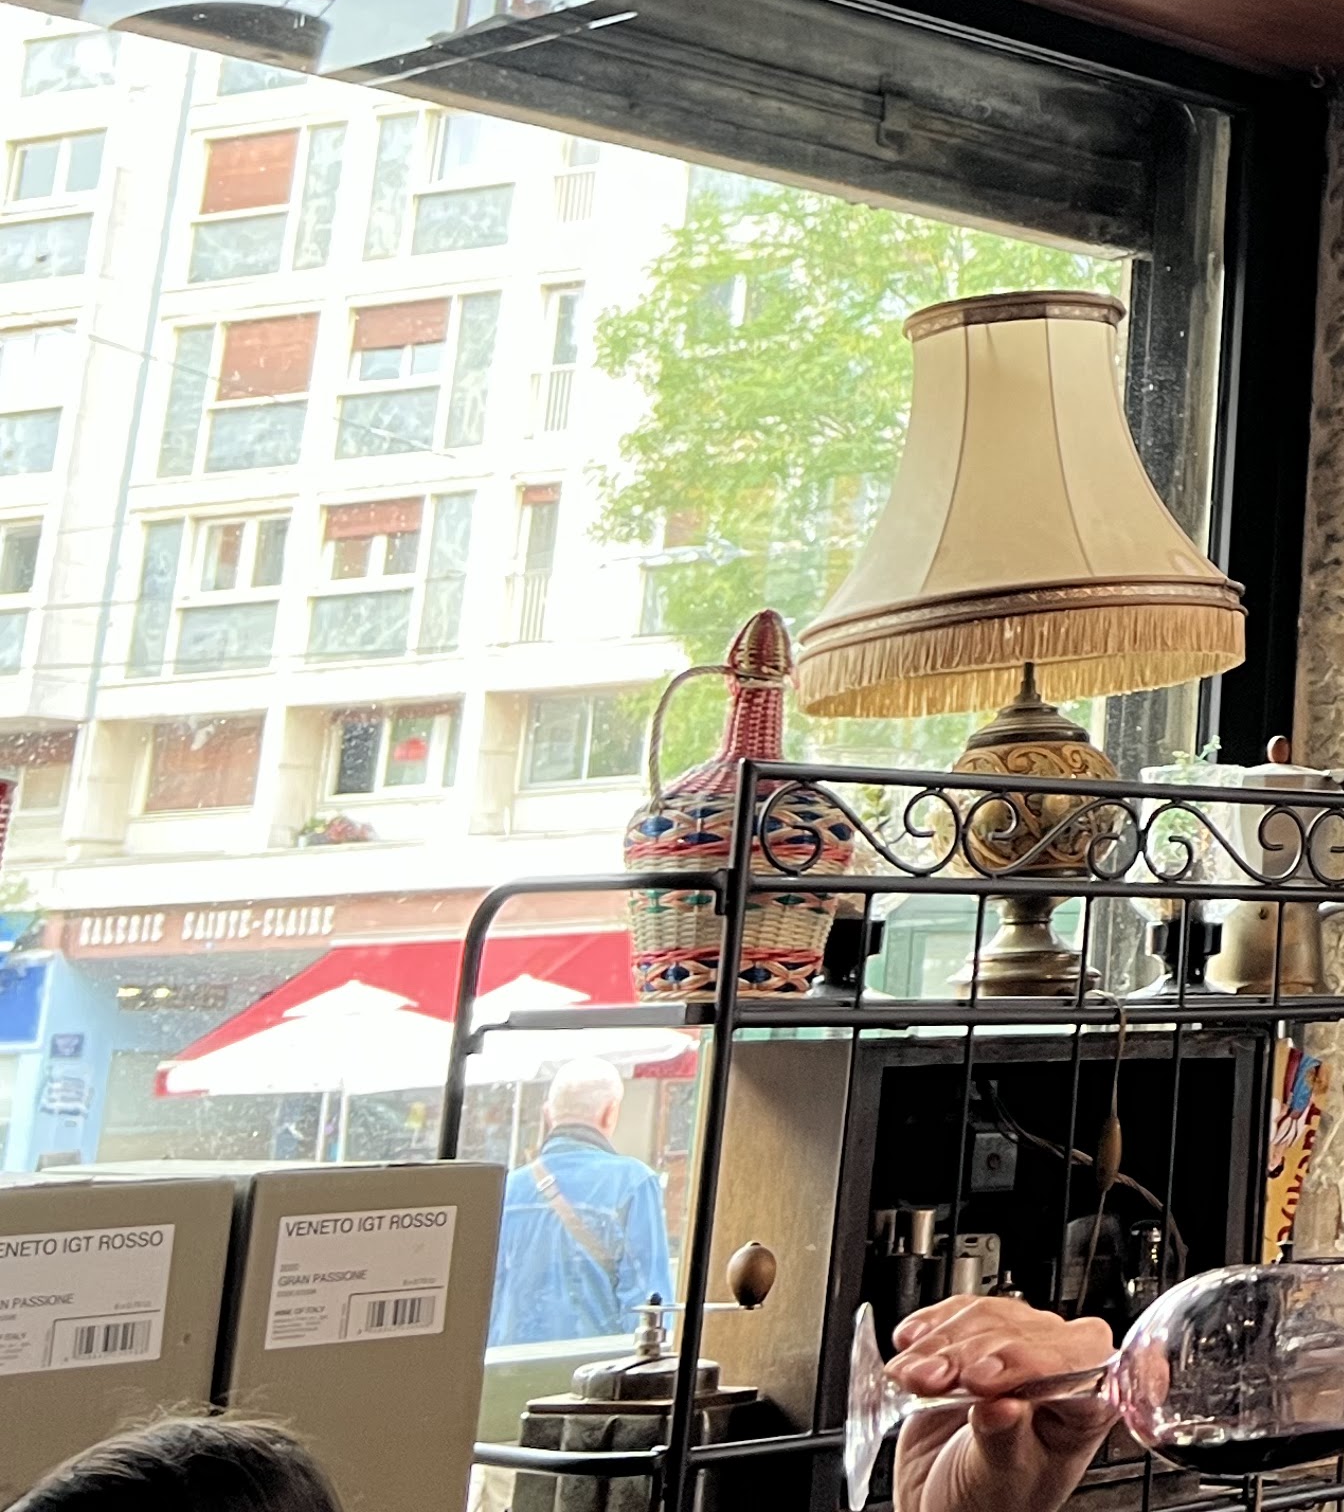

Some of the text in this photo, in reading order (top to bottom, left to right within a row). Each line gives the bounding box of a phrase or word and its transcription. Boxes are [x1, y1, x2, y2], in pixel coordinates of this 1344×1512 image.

[285, 1211, 448, 1237] VENETO IGT ROSSO
[62, 1236, 95, 1254] IGT
[98, 1230, 164, 1251] ROSSO
[278, 1269, 368, 1287] GRAN PASSIONE
[11, 1292, 75, 1309] PASSIONE
